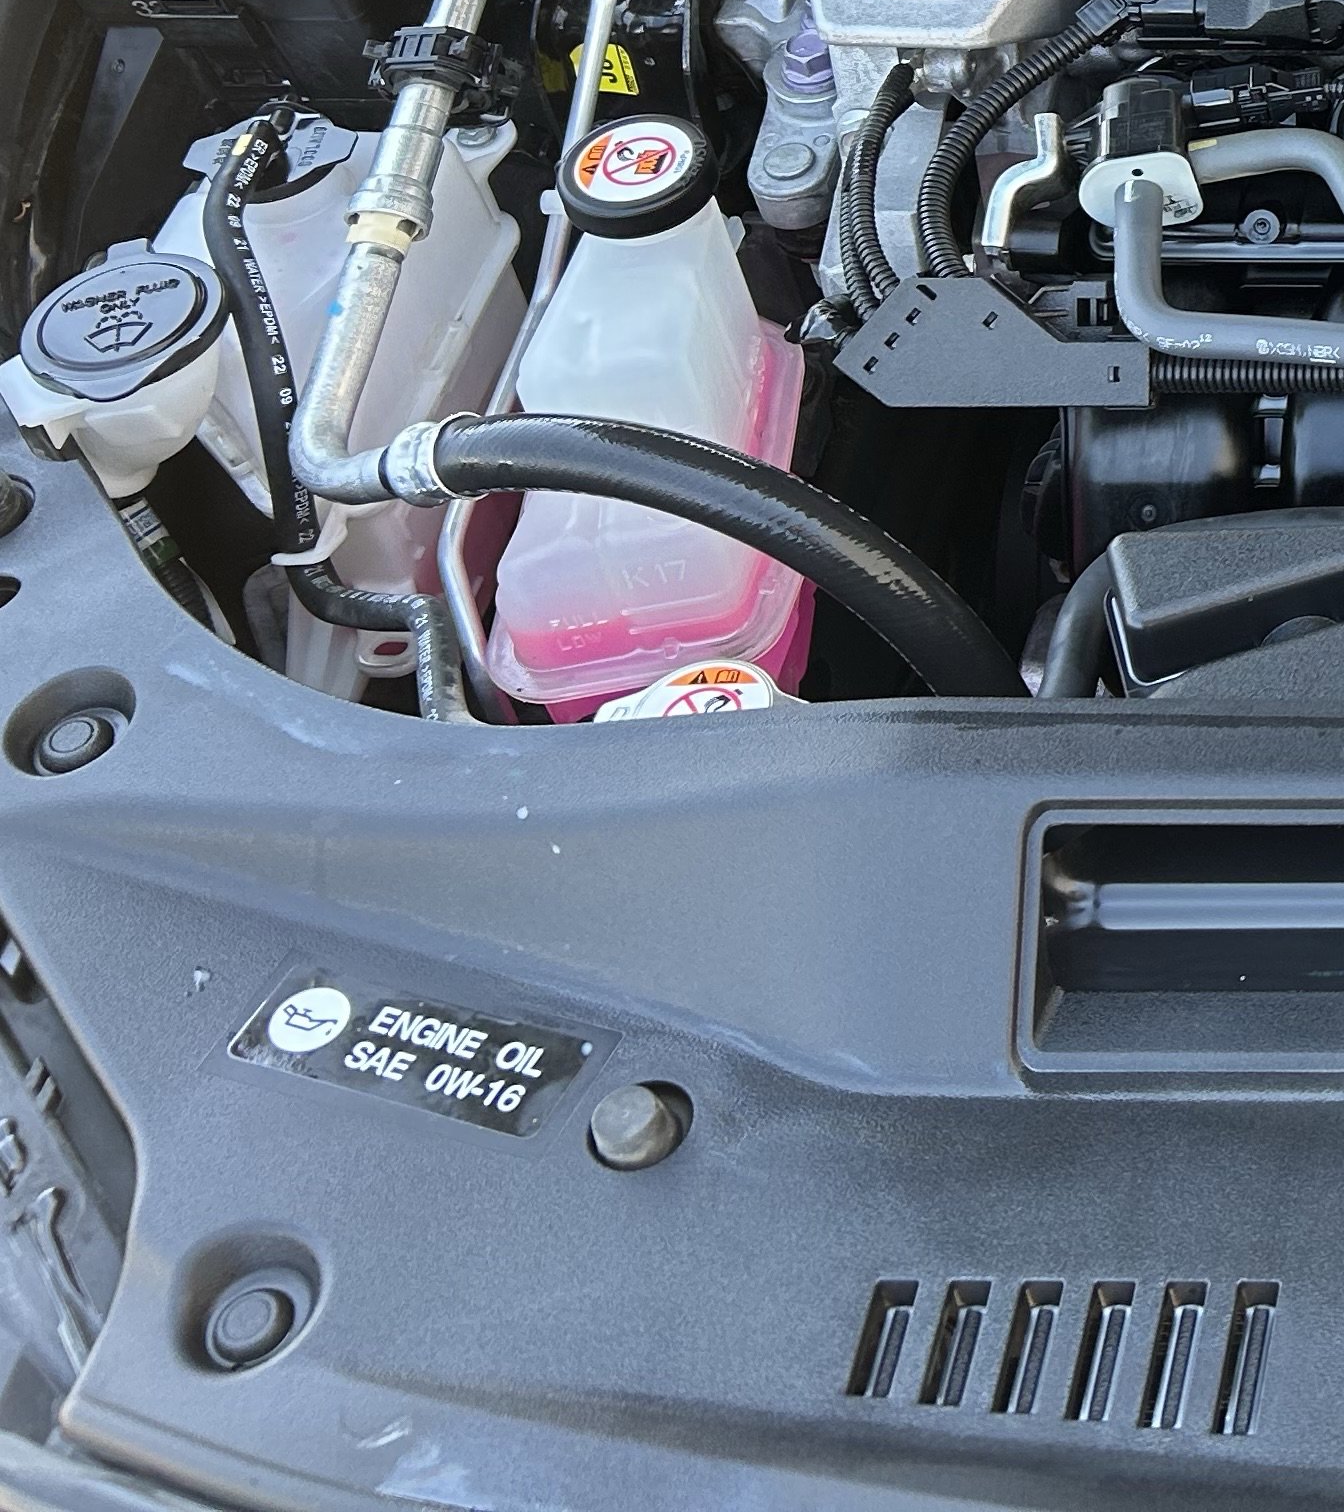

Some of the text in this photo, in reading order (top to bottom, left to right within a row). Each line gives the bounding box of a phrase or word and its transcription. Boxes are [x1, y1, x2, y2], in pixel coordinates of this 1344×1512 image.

[271, 354, 287, 375] 22
[279, 388, 293, 405] 09
[344, 1041, 417, 1081] SAE
[368, 1005, 545, 1078] ENGINE OIL
